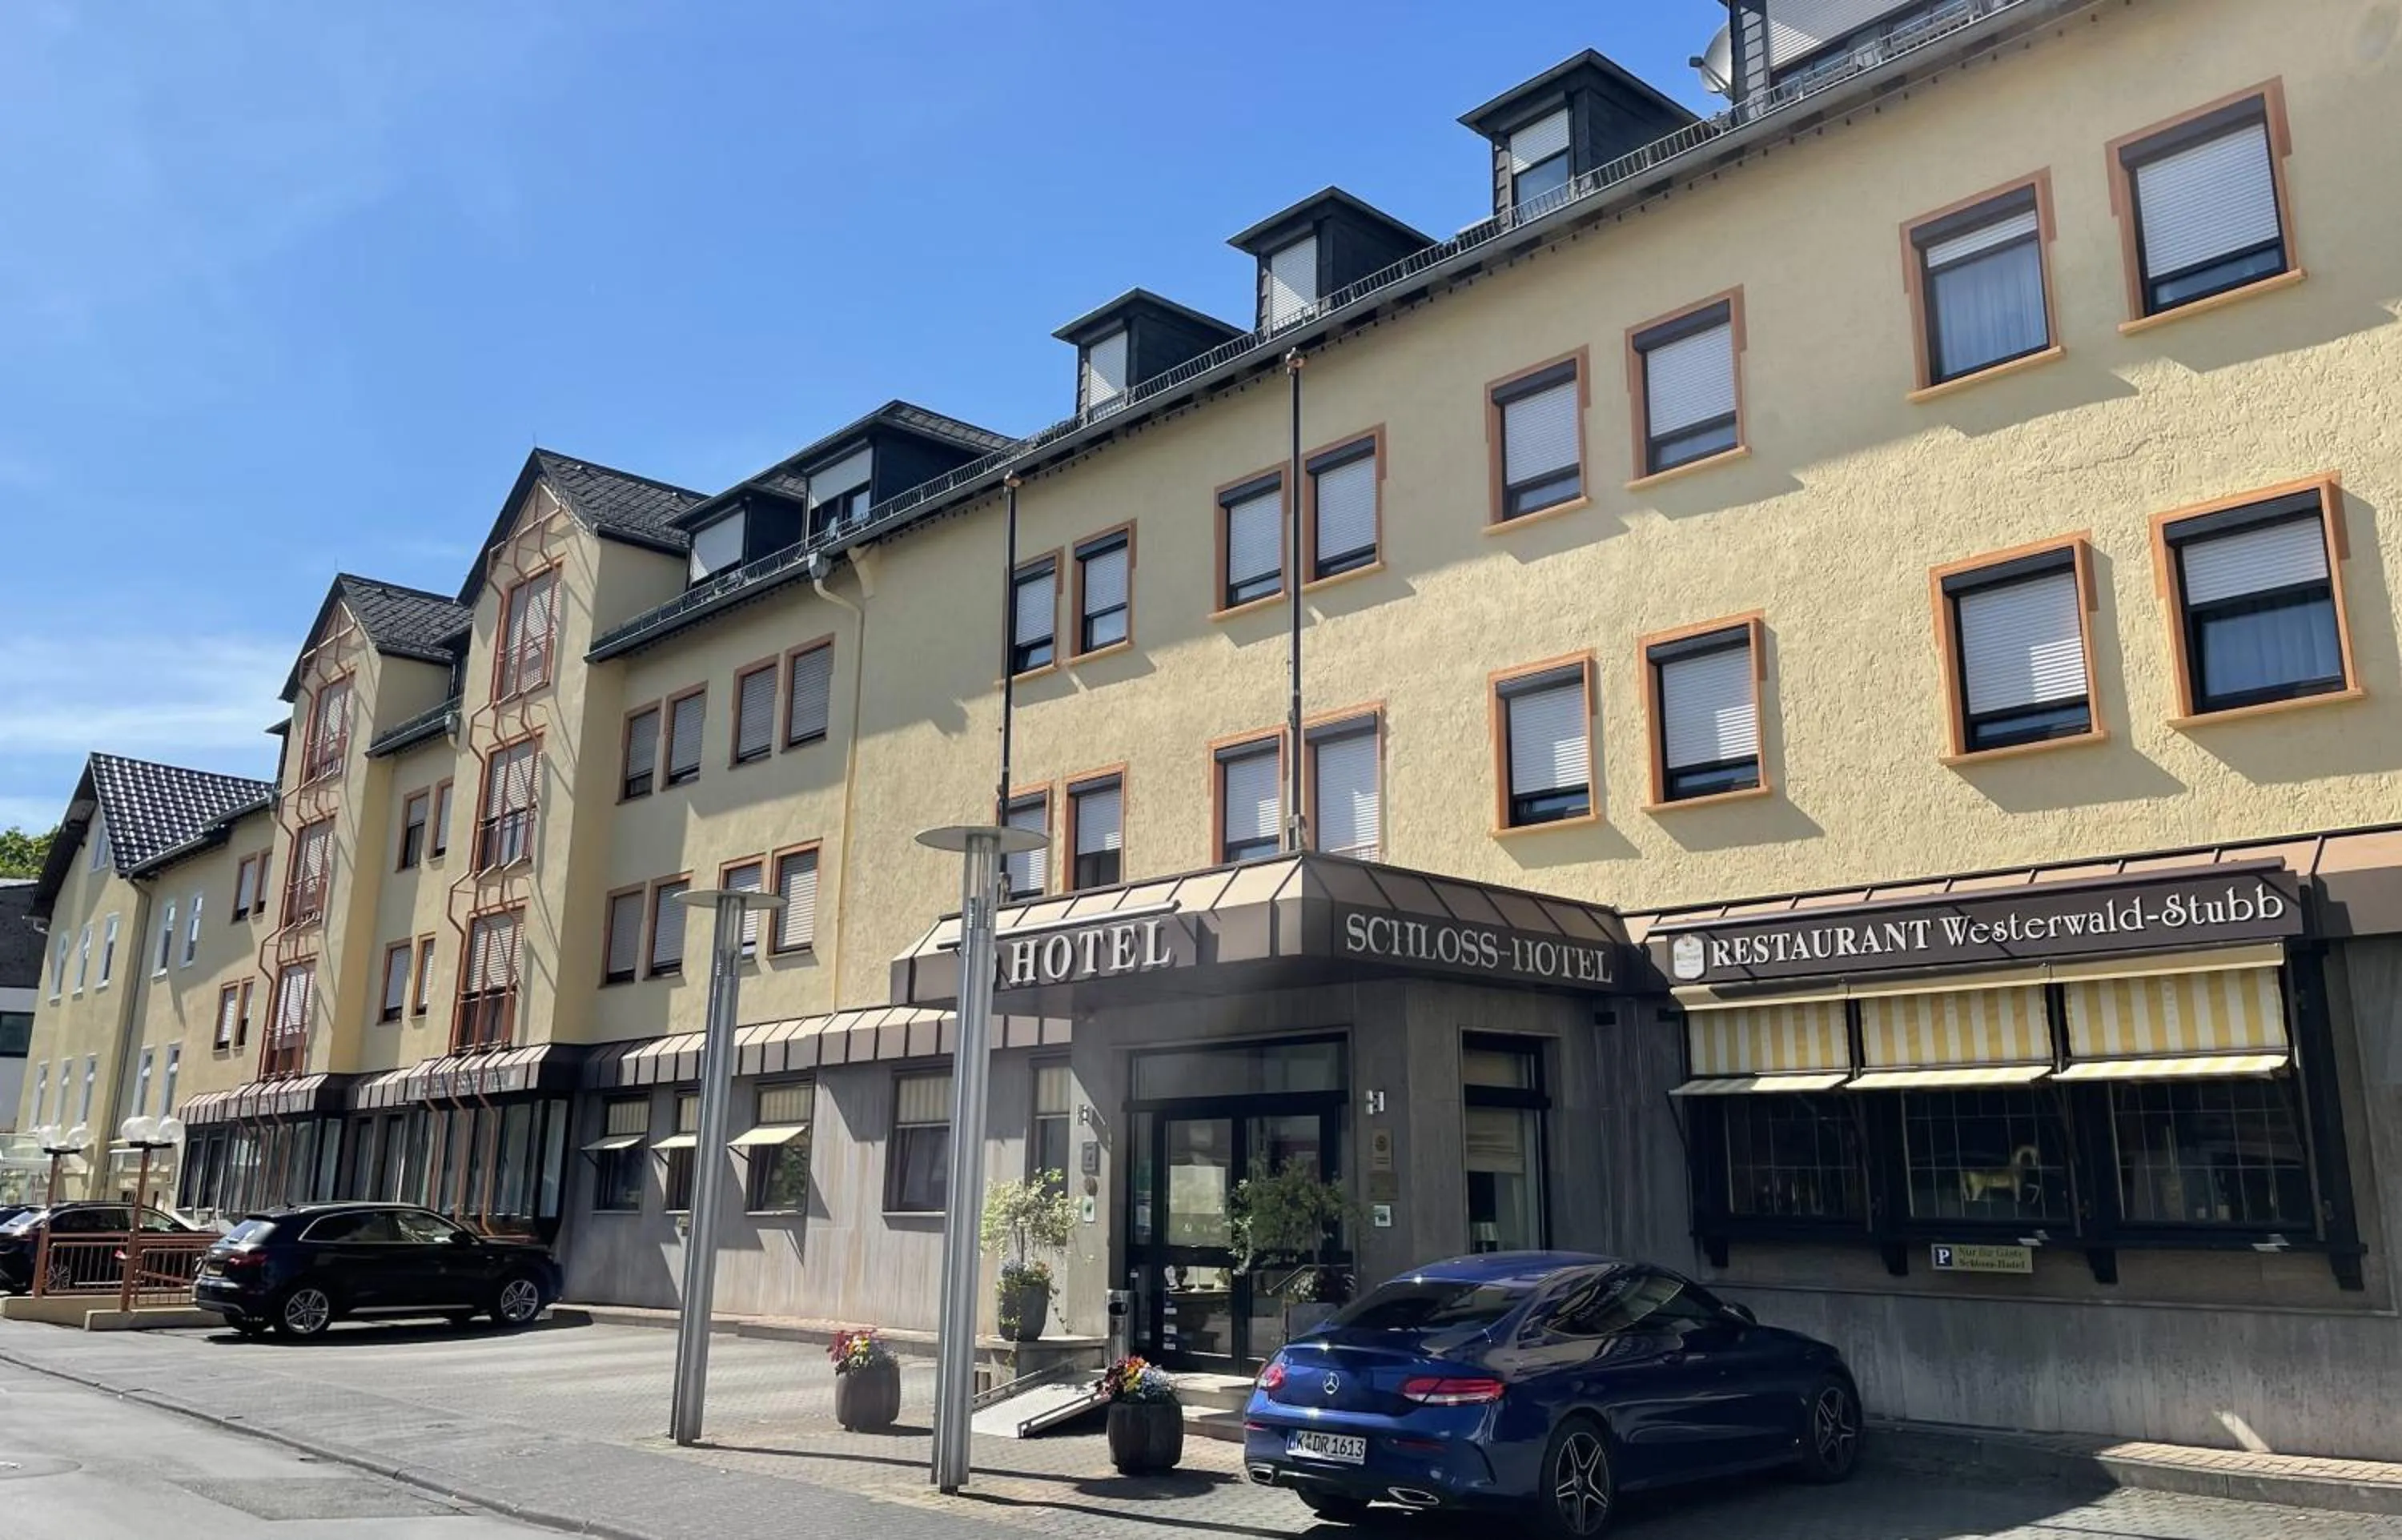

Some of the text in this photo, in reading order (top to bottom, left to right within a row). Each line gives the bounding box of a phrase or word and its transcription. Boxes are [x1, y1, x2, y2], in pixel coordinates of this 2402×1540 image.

[1008, 920, 1171, 985] HOTEL
[1345, 912, 1613, 985] SCHLOSS-HOTEL
[1711, 882, 2285, 968] RESTAURANT Westerwald-Stubb
